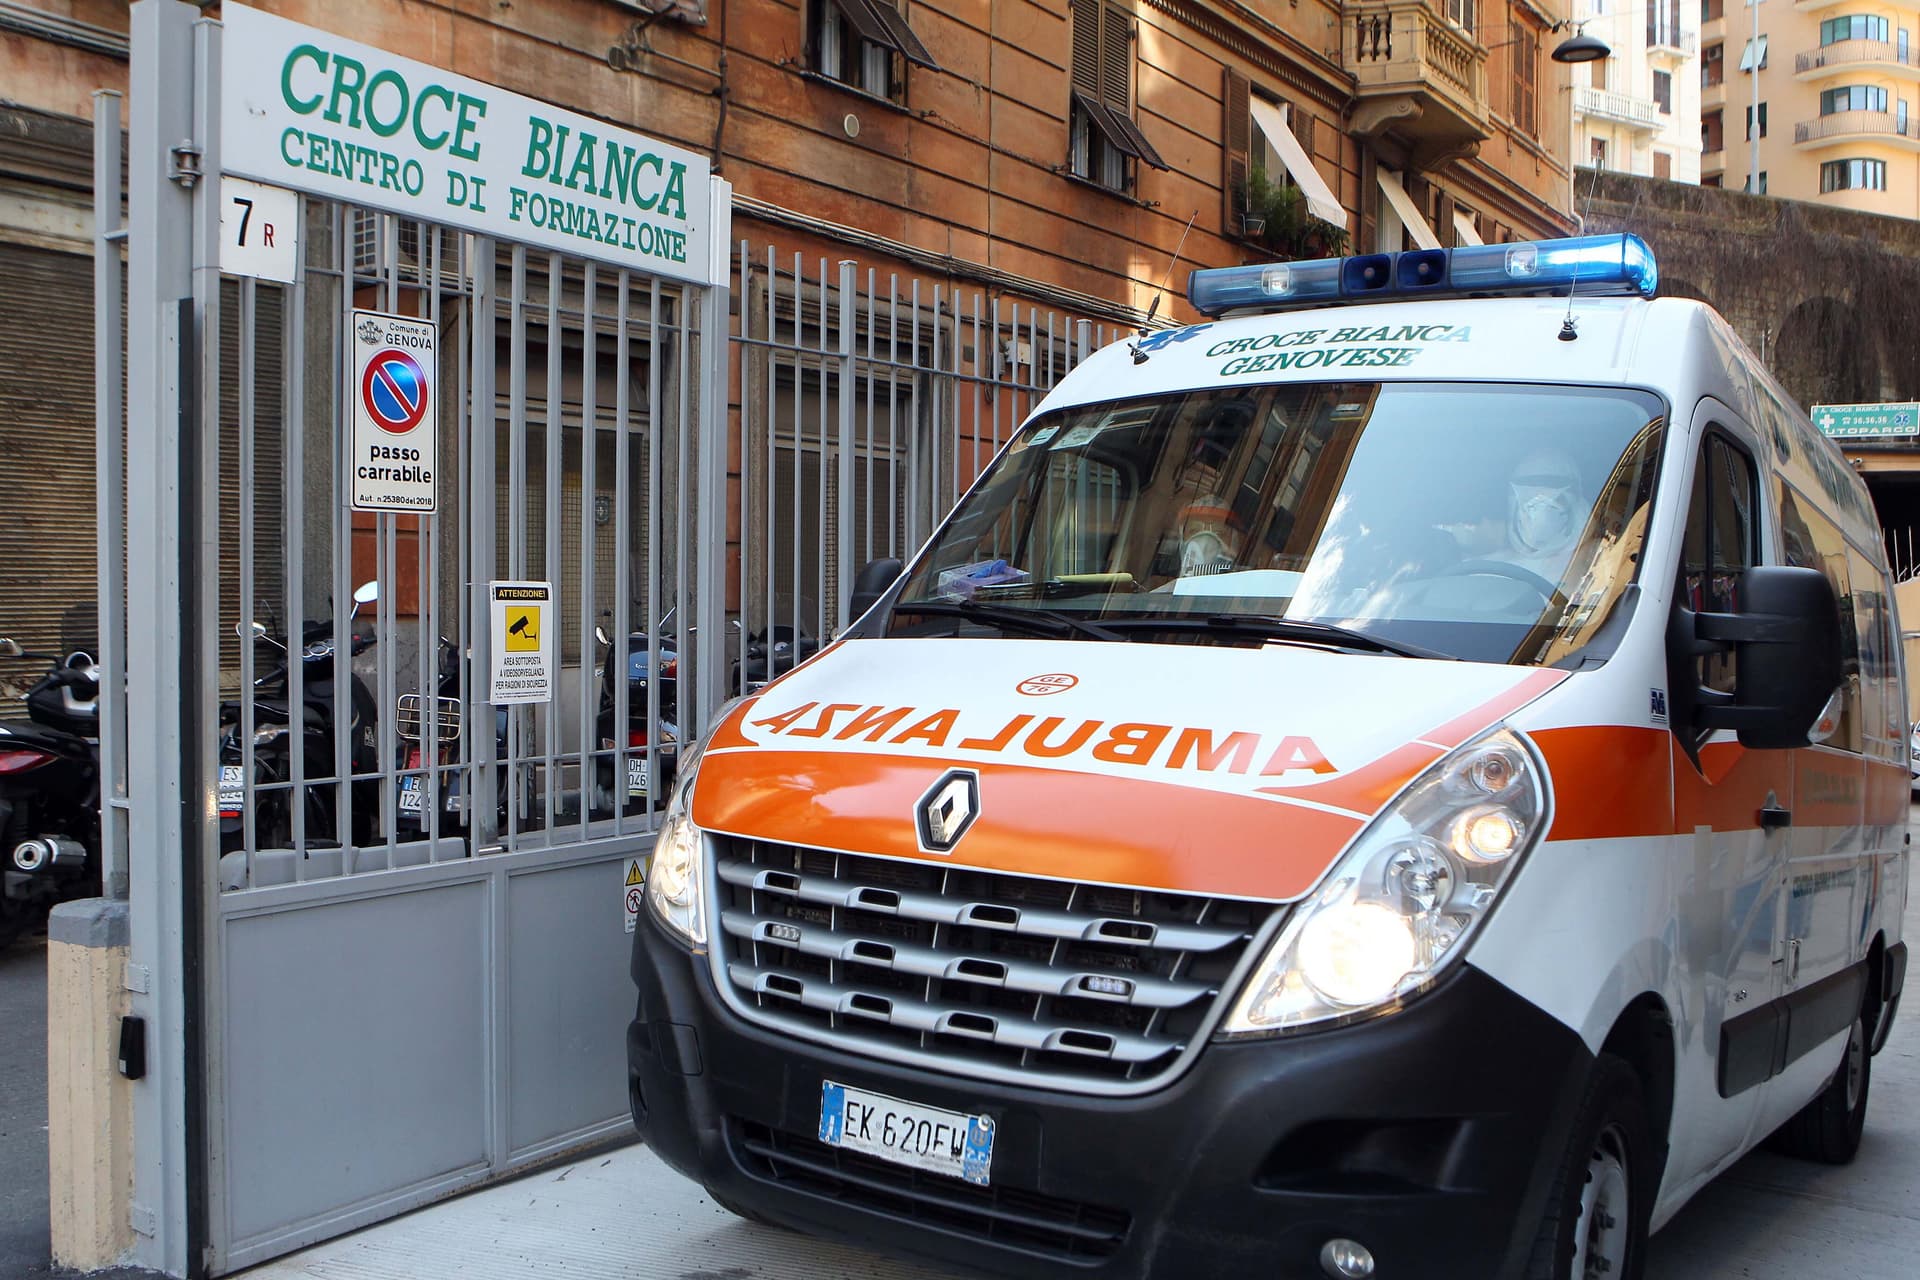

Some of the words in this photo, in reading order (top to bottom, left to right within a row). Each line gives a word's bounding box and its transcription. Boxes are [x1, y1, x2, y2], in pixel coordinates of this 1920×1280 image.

[281, 44, 487, 161] CROCE
[521, 116, 687, 221] BIANCA
[281, 127, 424, 196] CENTRO
[446, 170, 486, 213] DI
[509, 187, 687, 264] FORMAZIONE
[233, 197, 253, 247] 7
[263, 223, 275, 249] R
[389, 322, 420, 335] Comune
[422, 327, 429, 336] di
[386, 333, 433, 350] GENOVA
[1205, 329, 1329, 358] CROCE
[1324, 325, 1473, 344] BIANCA
[1219, 347, 1424, 377] GENOVESE
[1823, 426, 1916, 435] UTOPARCO
[370, 445, 420, 462] passo
[357, 466, 432, 483] carrabile
[504, 656, 515, 666] AREA
[515, 655, 541, 665] SOTTOPOSTA
[495, 680, 504, 690] PER
[526, 679, 548, 689] SICUREZZA
[1040, 676, 1070, 684] GE
[223, 767, 239, 780] ES
[629, 759, 641, 771] DH
[844, 1101, 875, 1141] EK
